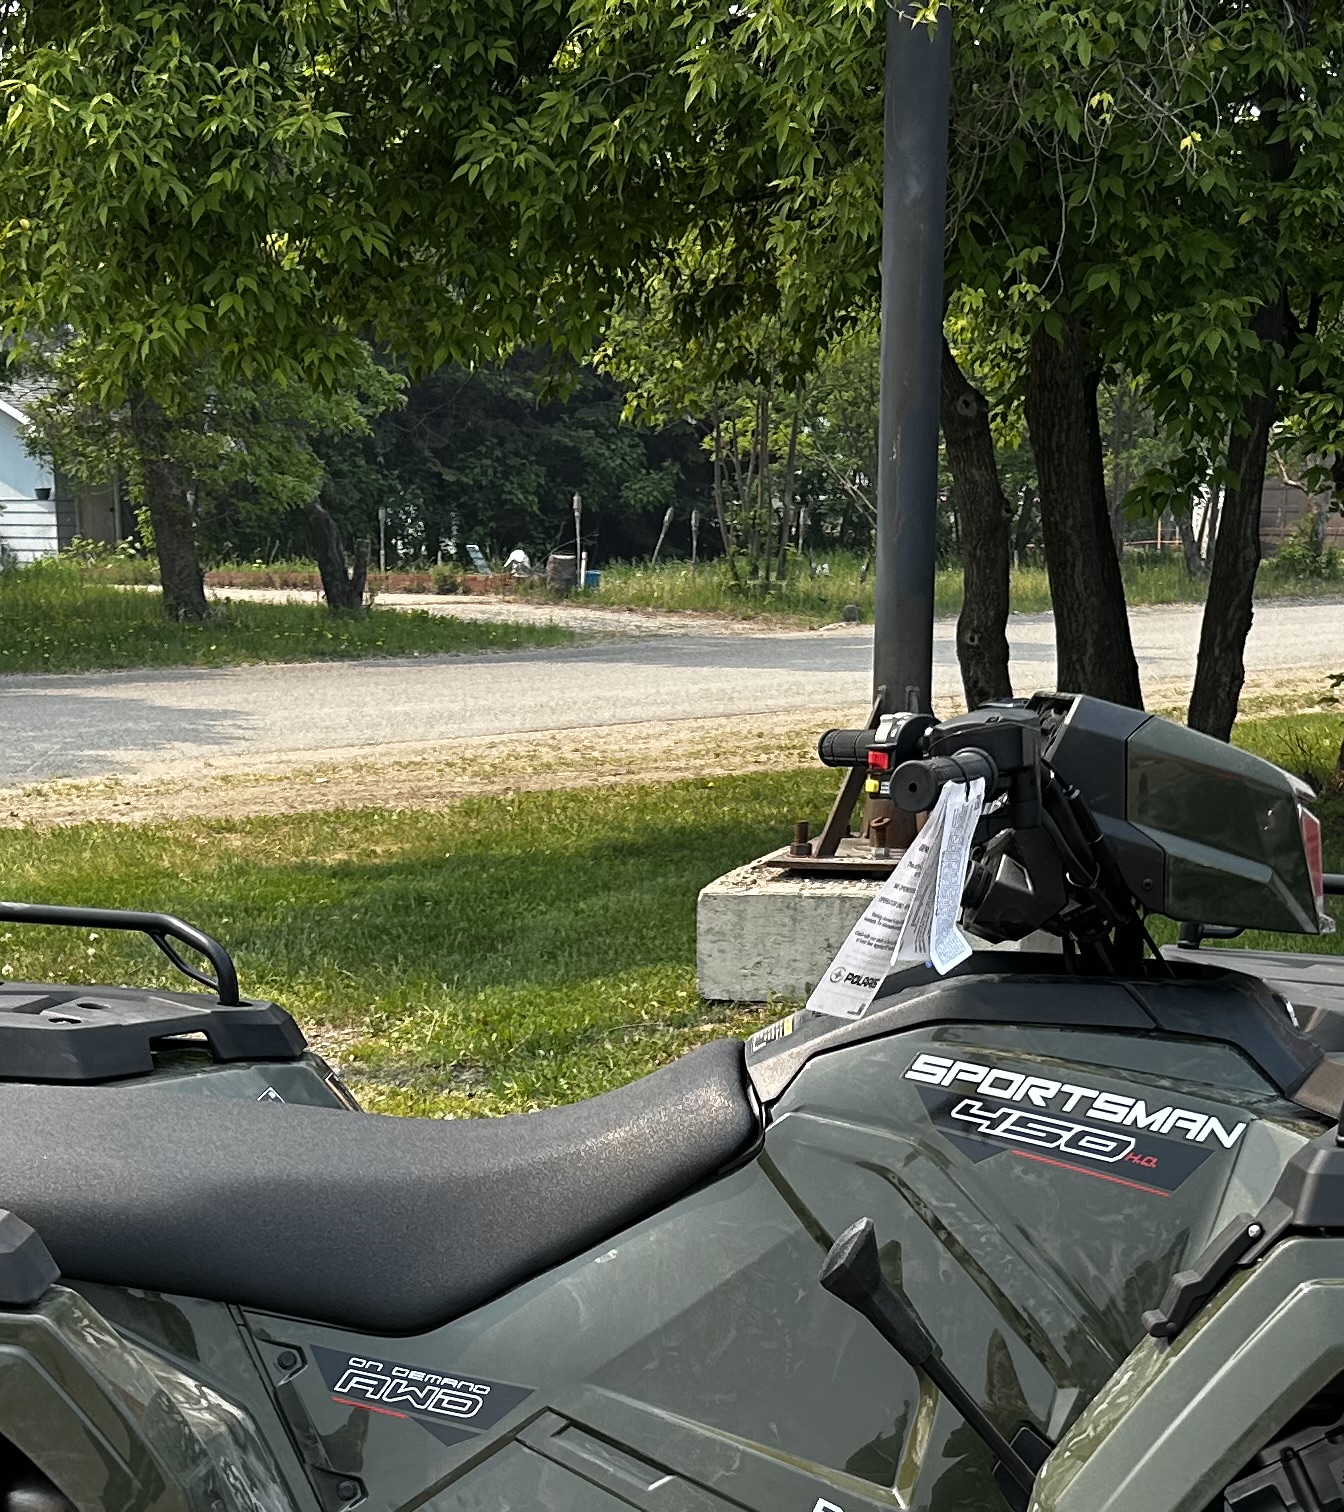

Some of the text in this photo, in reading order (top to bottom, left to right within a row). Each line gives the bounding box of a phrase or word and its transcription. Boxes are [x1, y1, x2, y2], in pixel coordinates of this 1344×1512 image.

[843, 972, 881, 989] POLARIS
[904, 1053, 1248, 1148] SPORTSMAN
[951, 1098, 1136, 1163] 450
[333, 1368, 484, 1419] AWD
[391, 1366, 491, 1396] DEMAND
